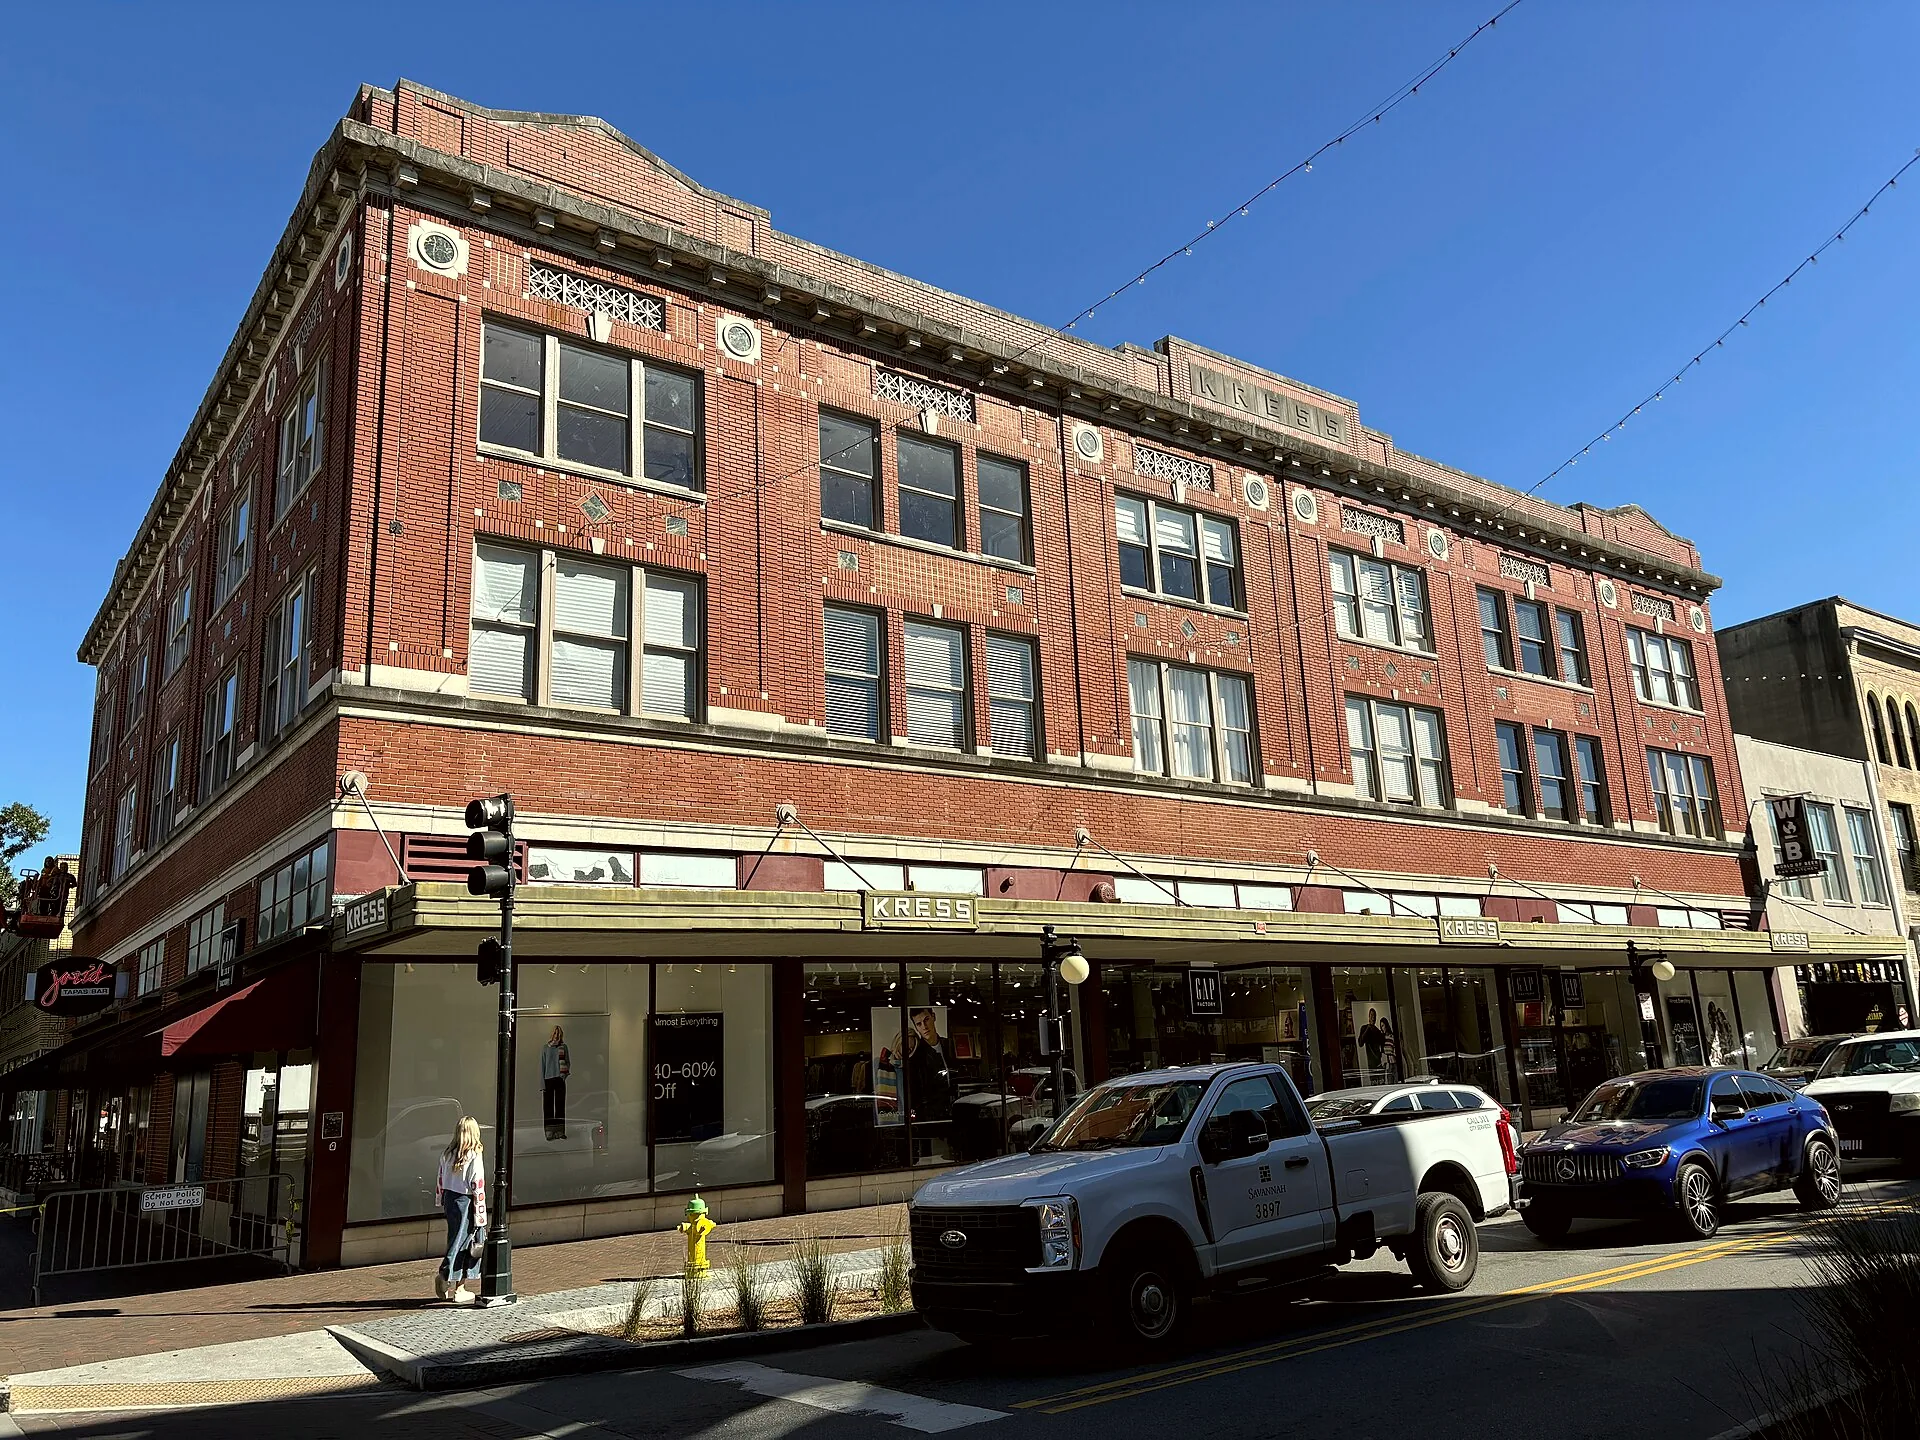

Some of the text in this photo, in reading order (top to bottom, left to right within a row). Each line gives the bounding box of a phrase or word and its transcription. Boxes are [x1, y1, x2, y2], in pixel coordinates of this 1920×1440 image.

[1198, 370, 1341, 438] KRESS
[346, 898, 386, 931] KRESS
[873, 897, 971, 919] KRESS
[1443, 920, 1497, 936] KRESS
[1773, 933, 1807, 946] KRESS
[1195, 977, 1215, 1000] GAP
[1516, 976, 1534, 992] GAP
[1564, 978, 1578, 997] GAP
[680, 1017, 718, 1027] Everything
[145, 1190, 201, 1200] SCMPD Police
[1256, 1201, 1280, 1219] 3897
